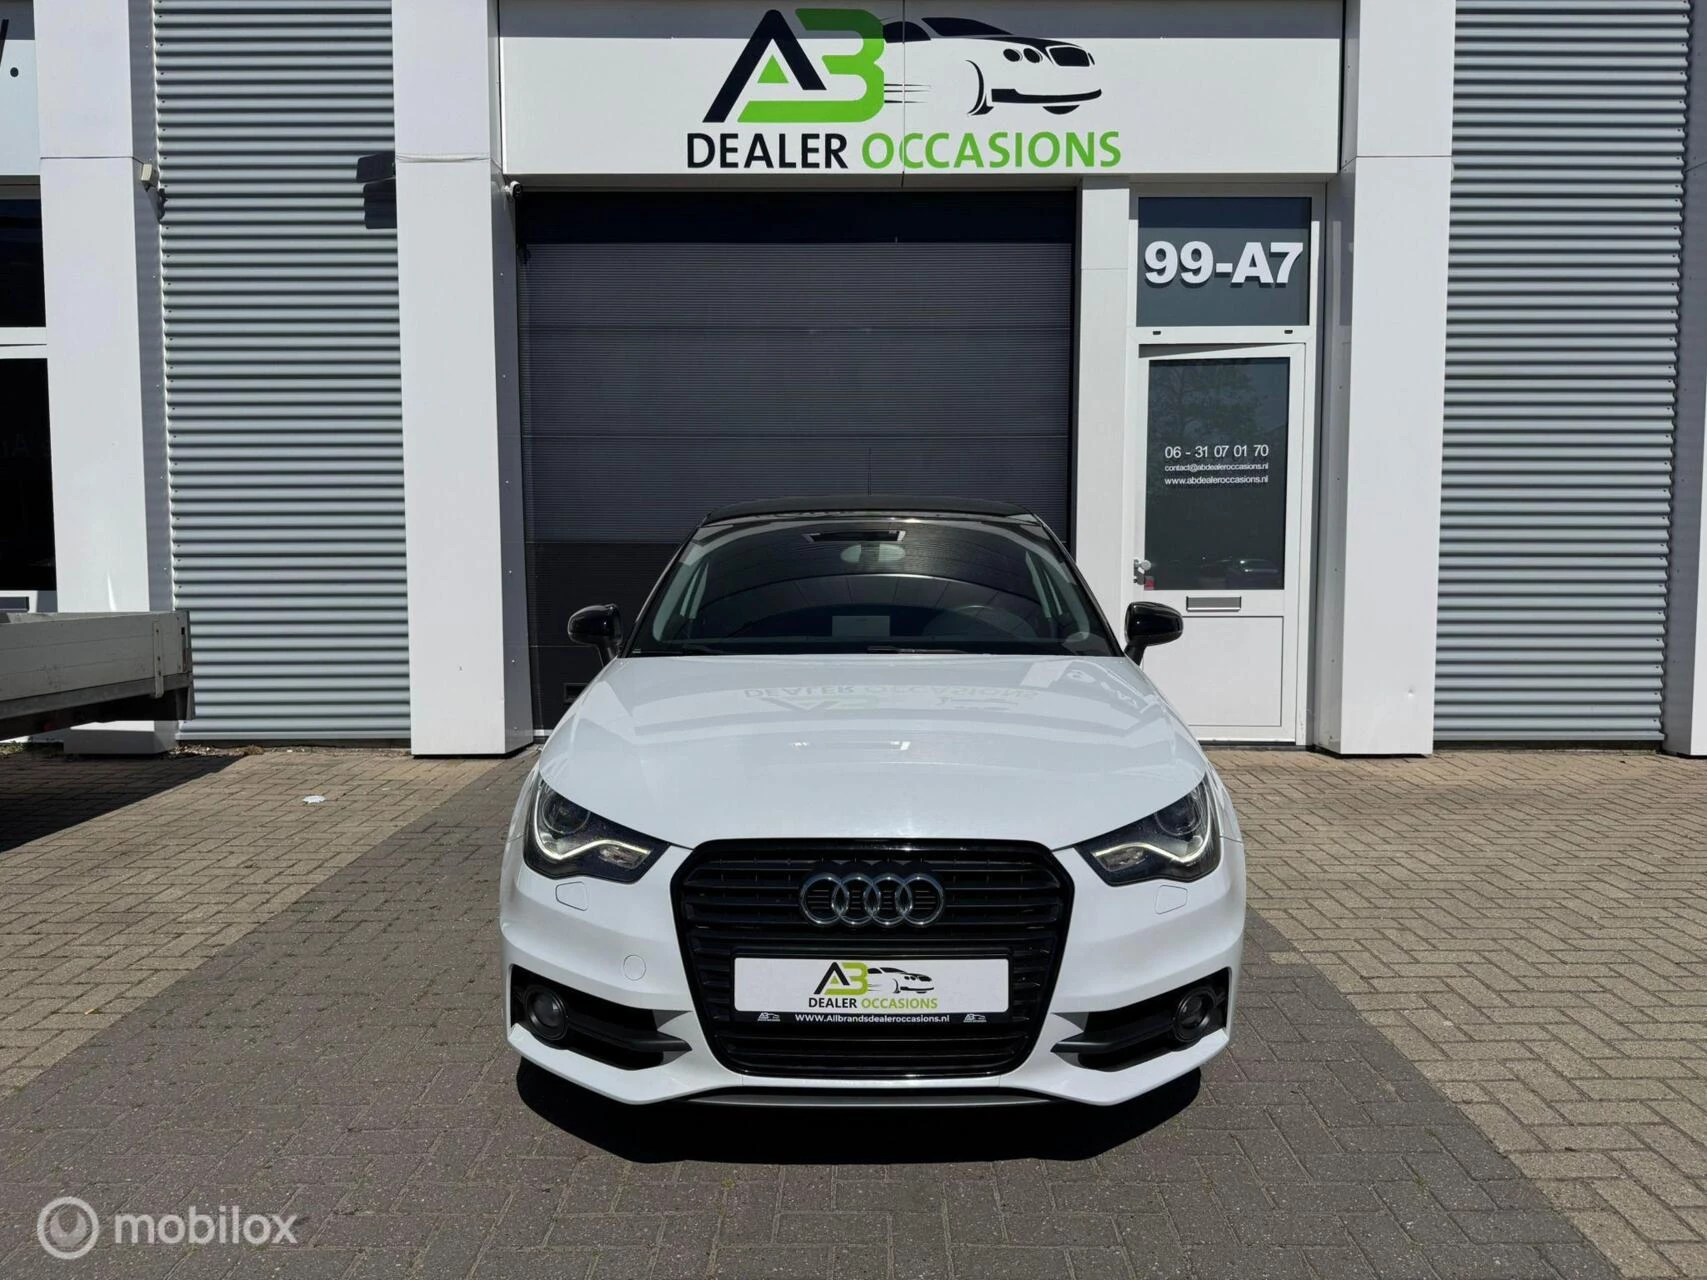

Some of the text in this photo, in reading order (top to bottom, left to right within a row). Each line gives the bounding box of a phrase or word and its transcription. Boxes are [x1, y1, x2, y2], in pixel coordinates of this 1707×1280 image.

[687, 131, 1121, 169] DEALER OCCASIONS
[1144, 240, 1304, 284] 99-A7
[1164, 446, 1181, 458] 06
[1194, 445, 1209, 458] 31
[1213, 445, 1229, 458] 07
[1233, 444, 1248, 457] 01
[1253, 444, 1269, 457] 70
[1164, 462, 1269, 472] contact@abdealeroccasions.nl
[1164, 475, 1269, 485] www.abdealeroccasions.nl
[808, 997, 938, 1010] DEALER OCCASIONS
